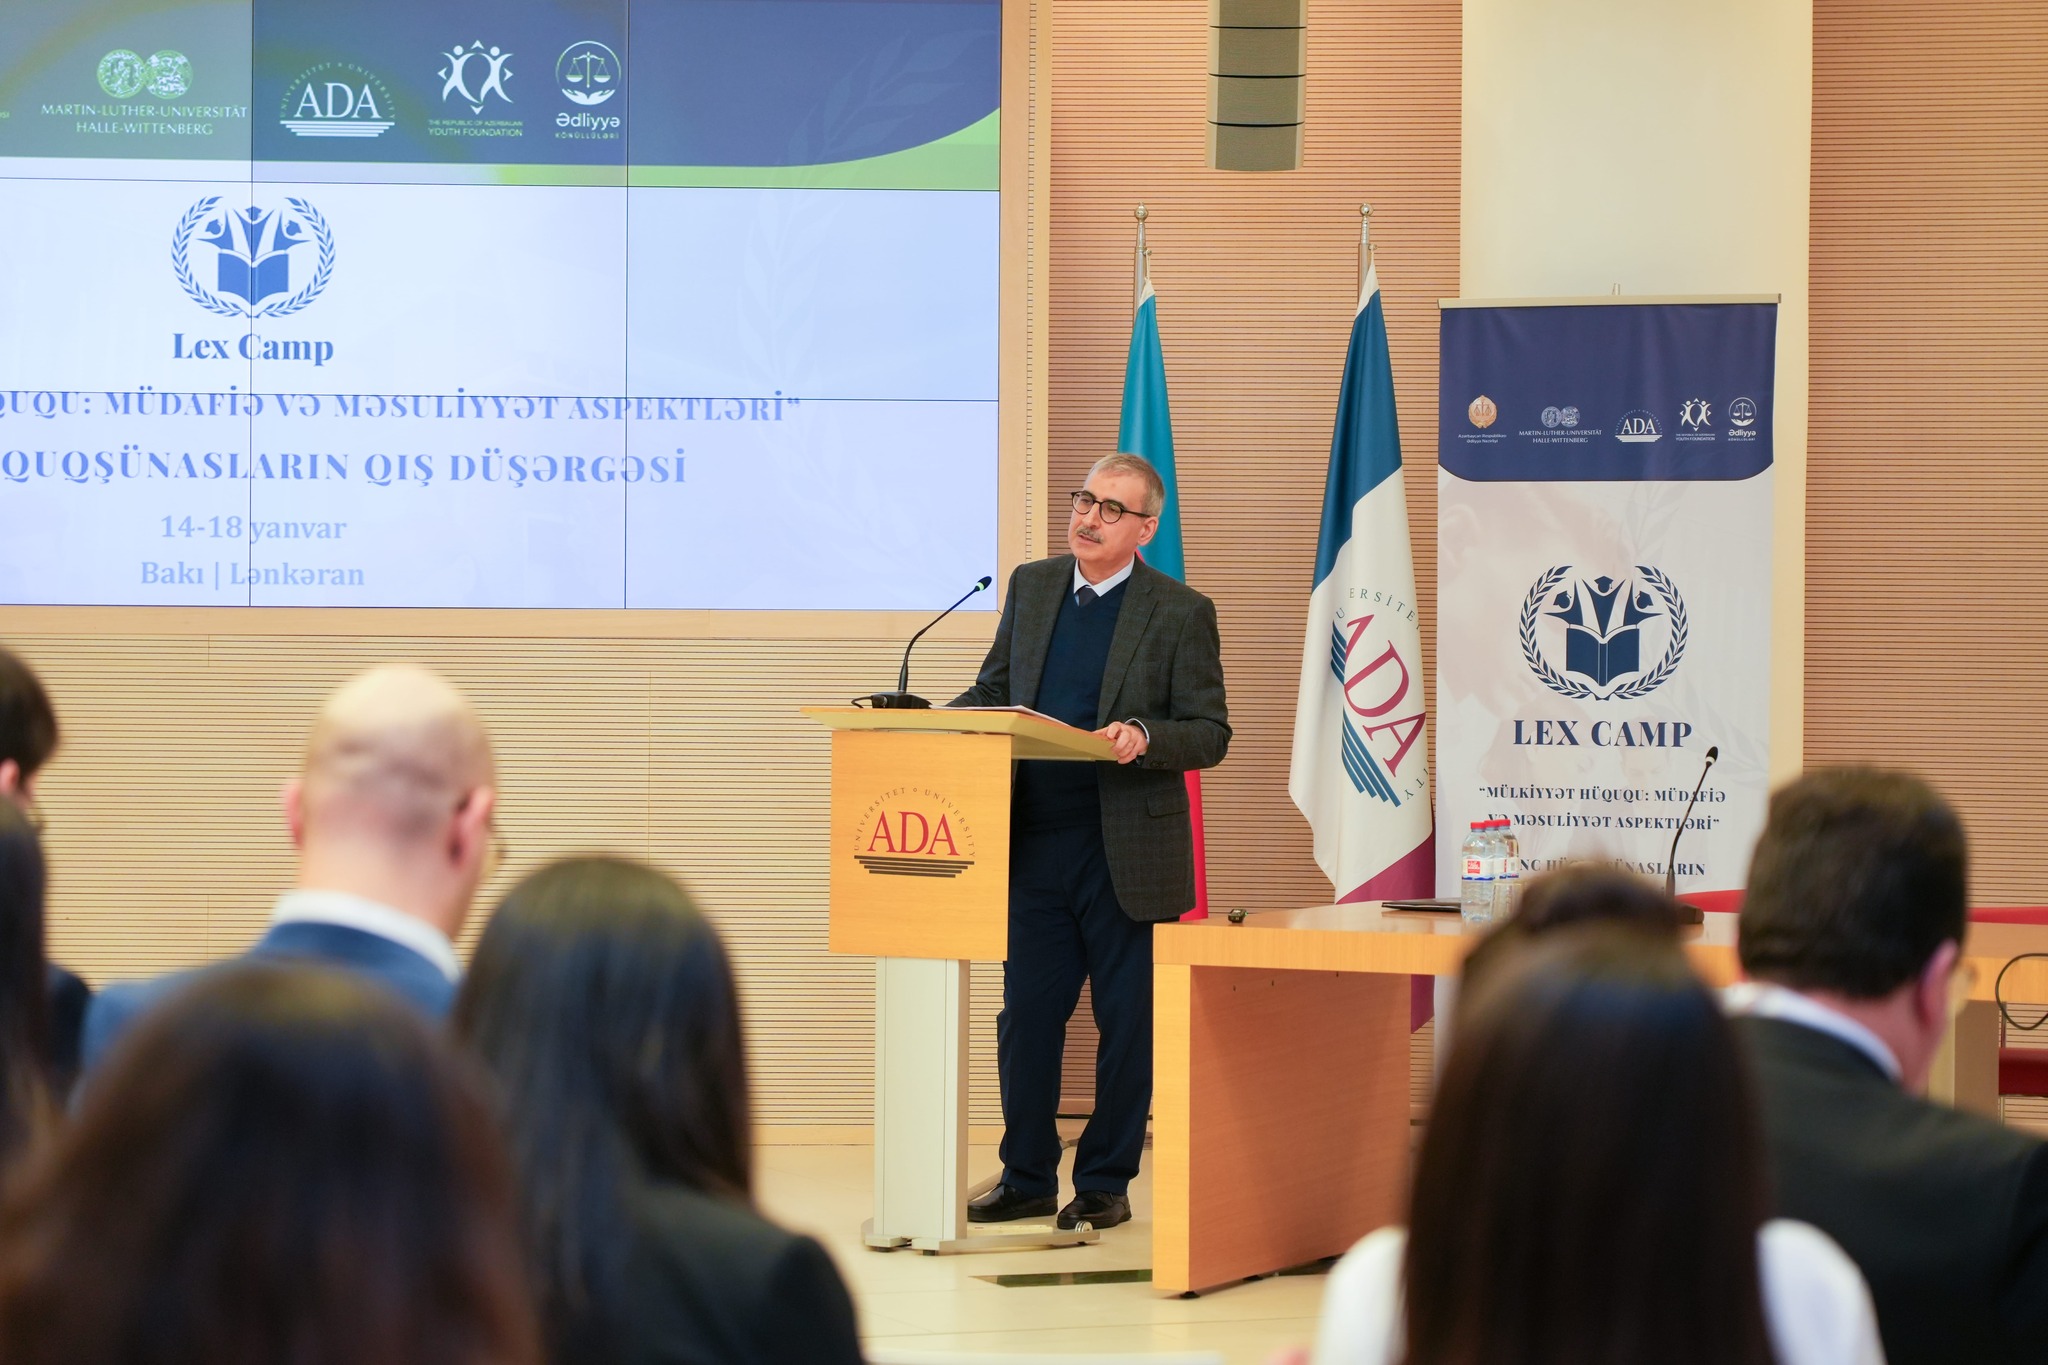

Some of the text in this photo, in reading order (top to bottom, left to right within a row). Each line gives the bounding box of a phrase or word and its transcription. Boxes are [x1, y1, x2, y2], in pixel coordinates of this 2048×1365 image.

[41, 104, 248, 119] MARTIN-LUTHER-UNIVERSITÄT
[293, 82, 382, 119] ADA
[76, 121, 214, 136] HALLE-WITTENBERG
[428, 127, 523, 137] YOUTH FOUNDATION
[555, 112, 621, 131] Ədliyyə
[172, 332, 335, 367] Lex Camp
[0, 391, 92, 419] UQU:
[105, 385, 264, 417] MÜDAFİƏ
[275, 394, 321, 418] VƏ
[334, 387, 560, 420] MƏSULİYYƏT
[1621, 417, 1657, 435] ADA
[365, 452, 434, 487] QIŞ
[450, 447, 687, 488] DÜŞƏRGƏSİ
[161, 515, 348, 545] 14-18 yanvar
[141, 561, 204, 584] Bakı
[230, 562, 365, 586] Lənkəran
[1513, 719, 1693, 748] LEX CAMP
[867, 810, 960, 856] ADA
[924, 789, 976, 857] UNIVERSITY
[1514, 812, 1612, 828] MƏSULİYYƏT
